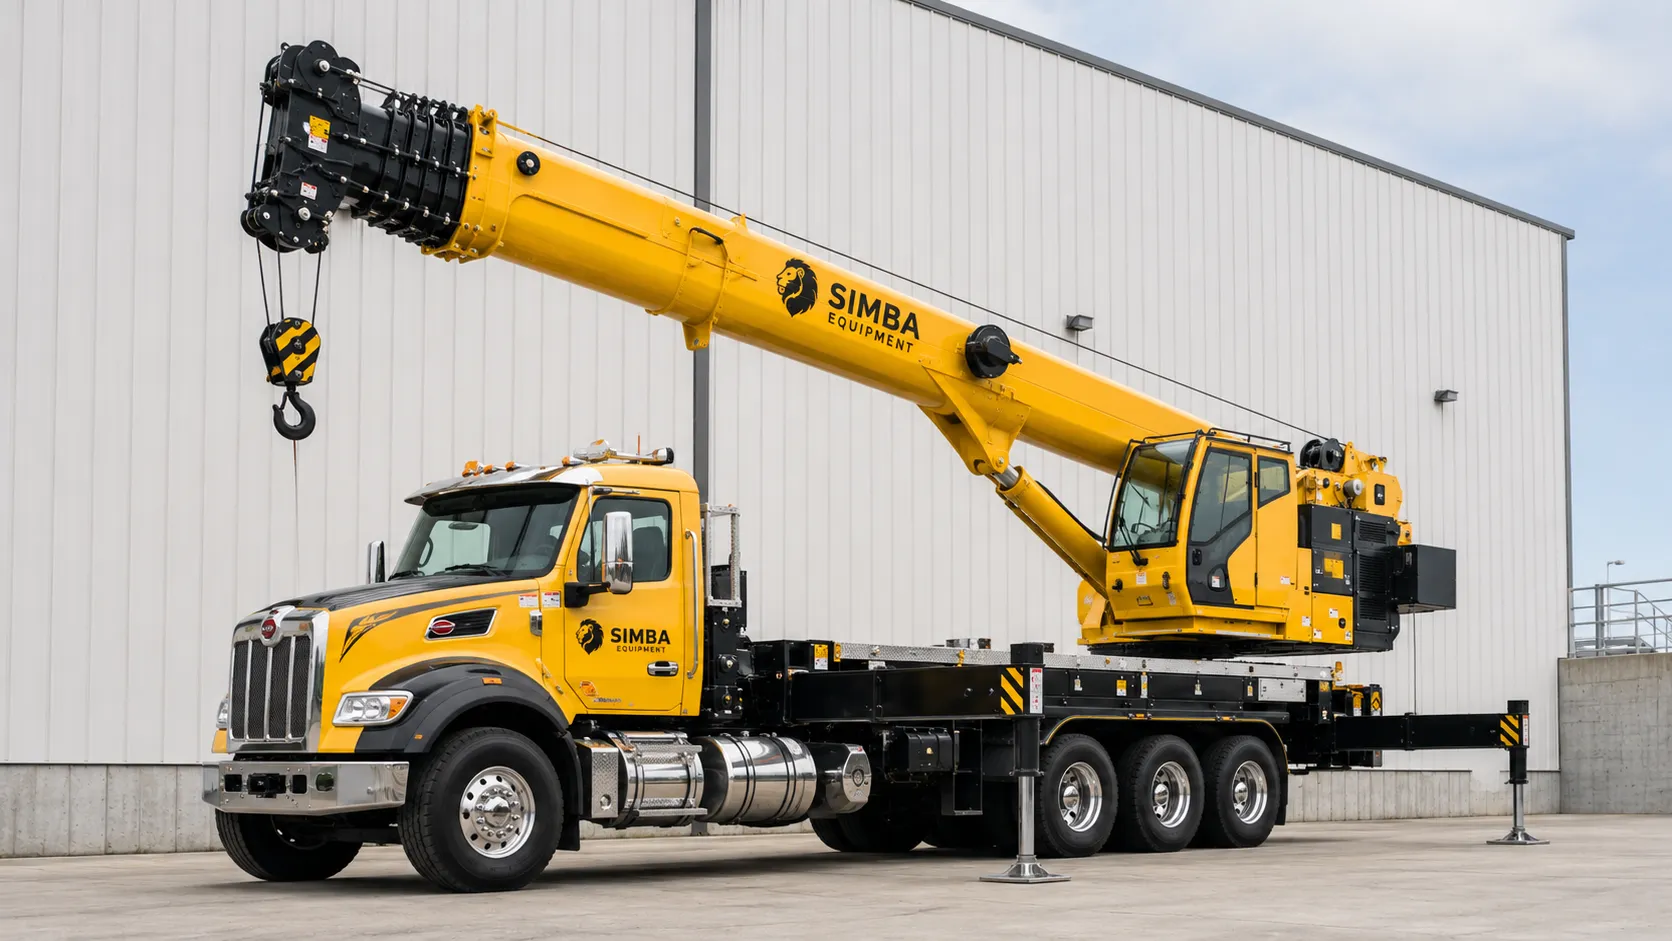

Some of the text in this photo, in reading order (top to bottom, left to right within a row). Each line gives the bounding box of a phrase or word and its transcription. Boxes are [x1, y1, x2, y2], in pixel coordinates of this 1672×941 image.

[828, 282, 920, 340] SIMBA
[828, 312, 914, 353] EQUIPMENT
[610, 627, 671, 645] SIMBA
[616, 645, 666, 653] EQUIPMENT
